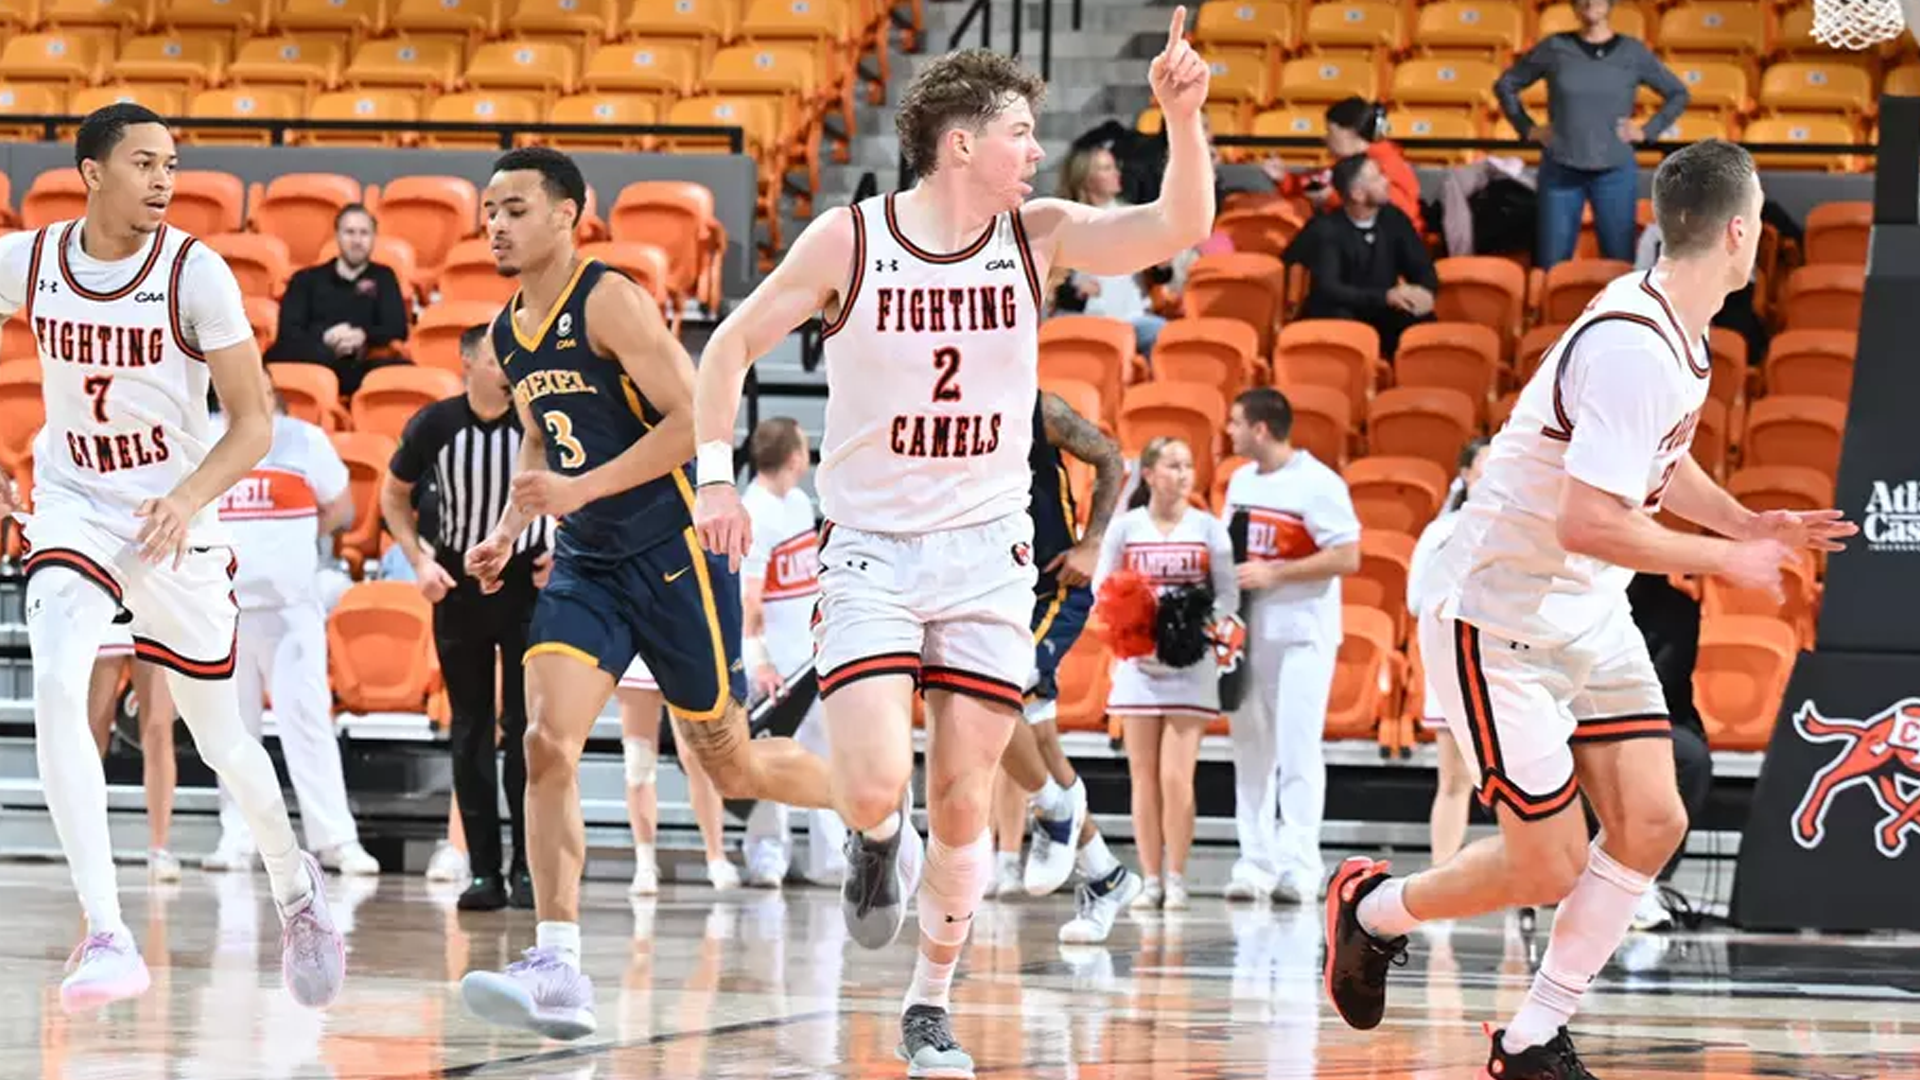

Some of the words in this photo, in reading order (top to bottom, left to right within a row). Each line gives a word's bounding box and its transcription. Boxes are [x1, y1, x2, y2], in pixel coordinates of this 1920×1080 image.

[984, 259, 1016, 271] CAA
[134, 291, 165, 303] CAA
[876, 285, 1017, 333] FIGHTING
[35, 316, 164, 367] FIGHTING
[514, 369, 598, 403] REXEL
[932, 346, 963, 402] 2
[84, 374, 113, 423] 7
[543, 410, 587, 469] 3
[891, 412, 1002, 458] CAMELS
[1865, 480, 1920, 513] Atl
